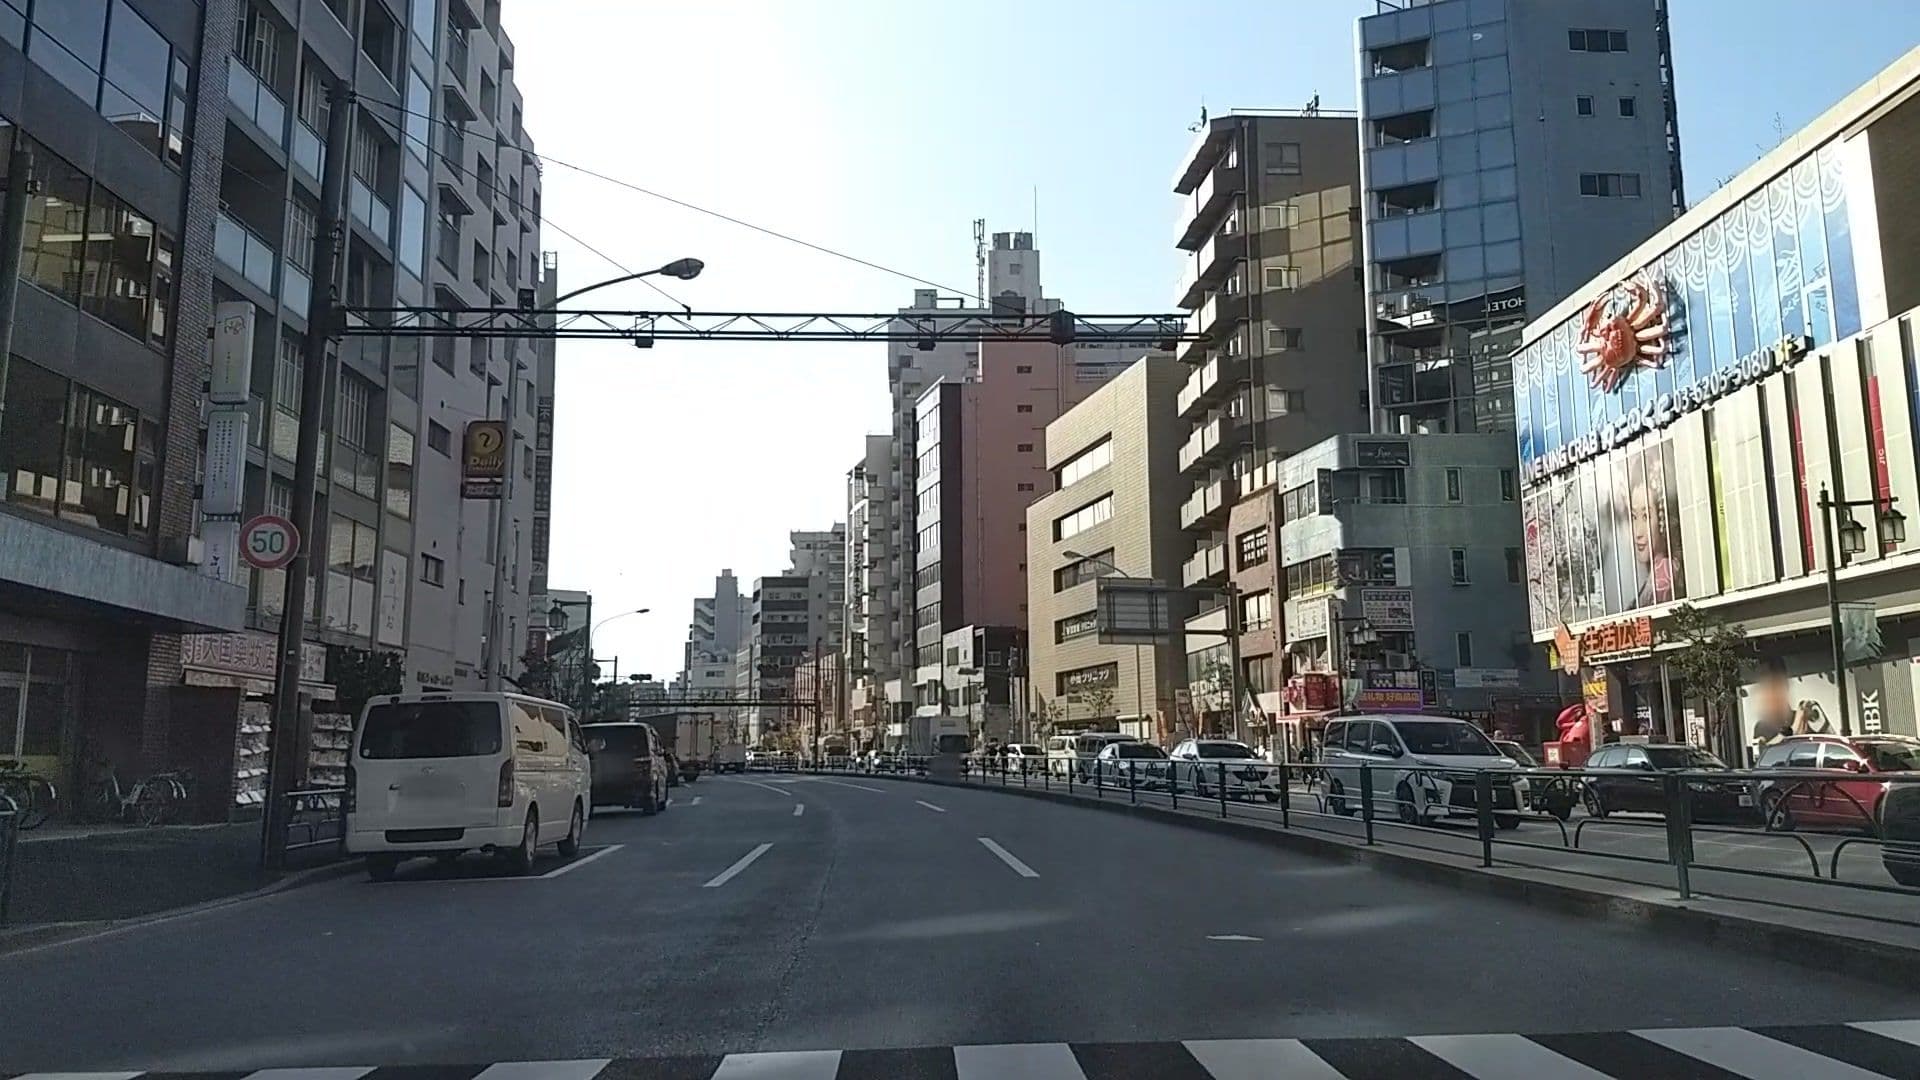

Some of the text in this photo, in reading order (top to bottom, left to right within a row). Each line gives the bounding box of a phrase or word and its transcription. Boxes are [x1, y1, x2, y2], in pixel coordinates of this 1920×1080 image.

[1521, 457, 1543, 485] LIVE
[1543, 445, 1566, 475] KING
[1568, 429, 1599, 463] CRAB
[1601, 394, 1672, 450] カニのくに
[1672, 346, 1771, 413] 03-6205-5080
[470, 456, 504, 470] Daily
[252, 531, 285, 554] 50
[1584, 616, 1653, 653] 生活広場
